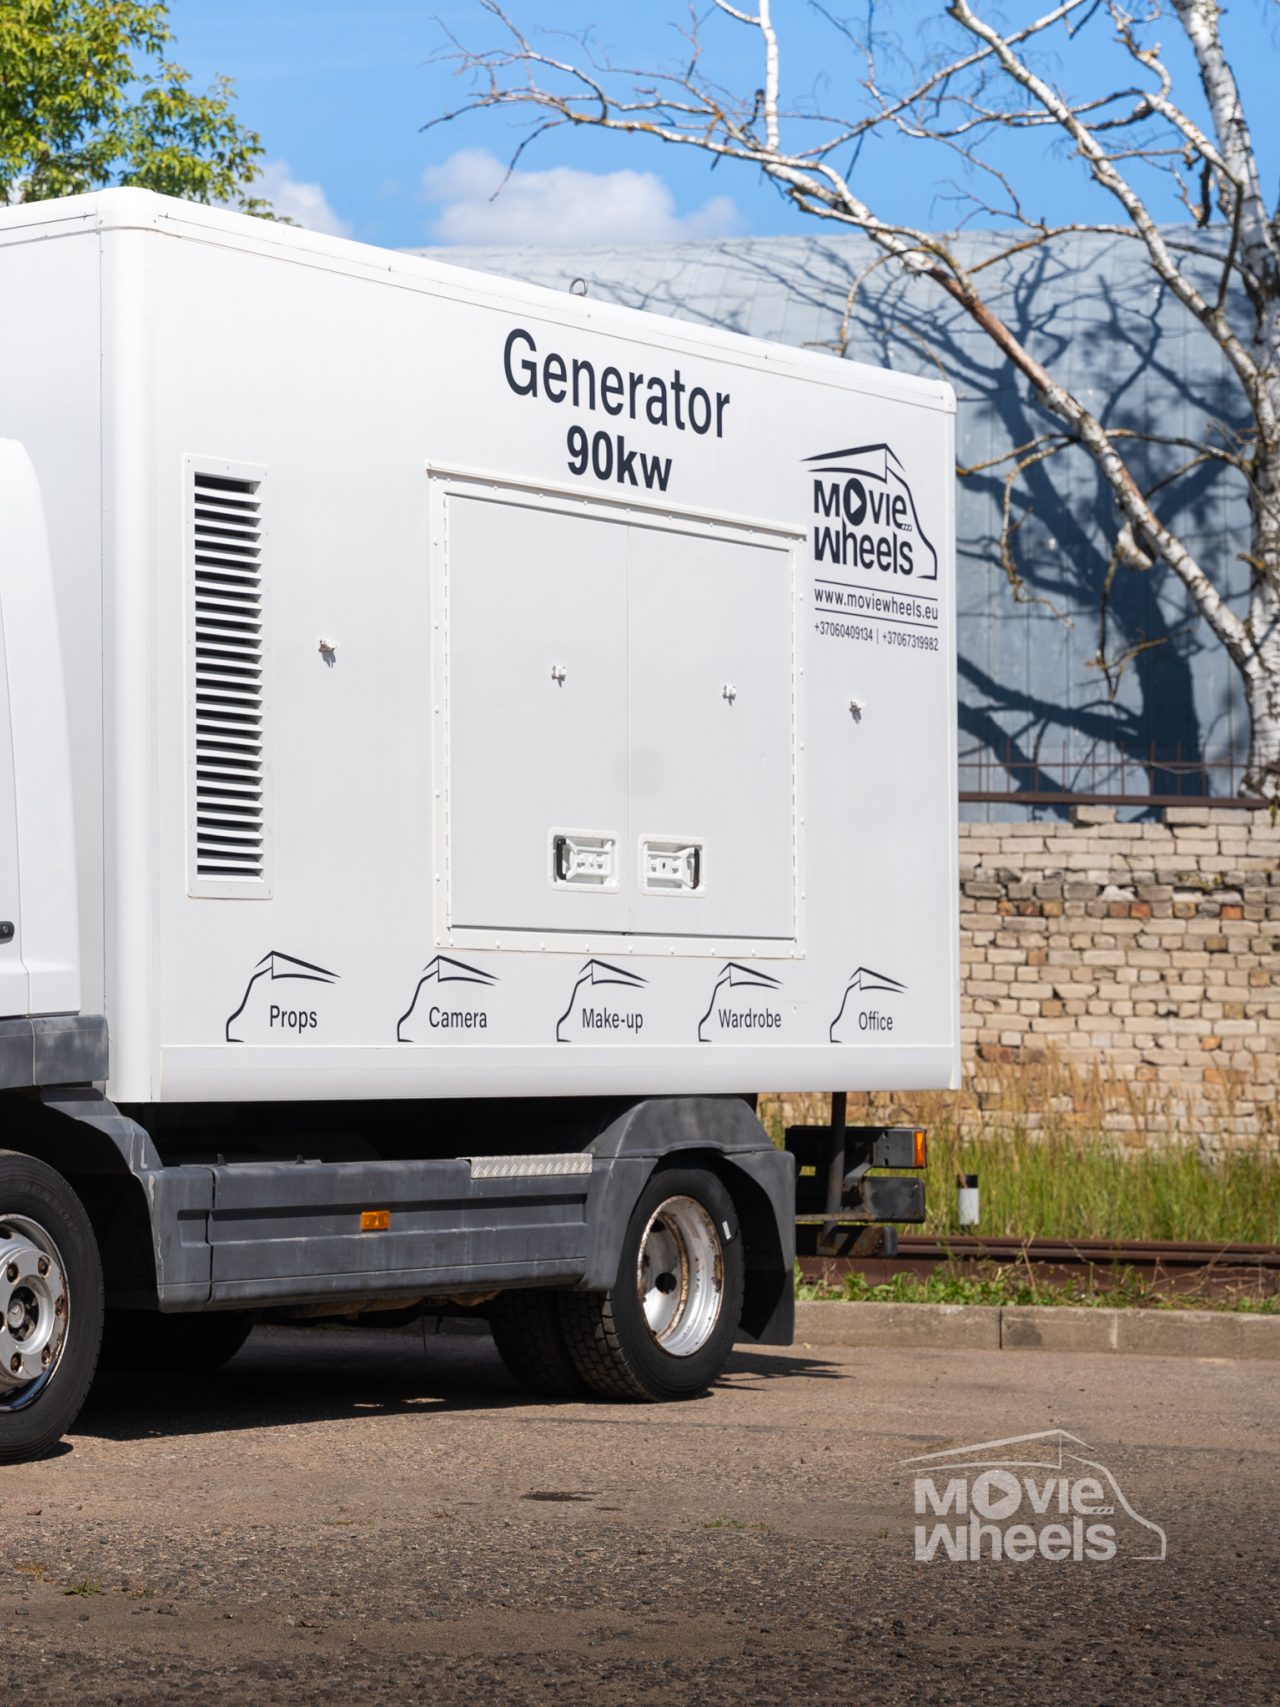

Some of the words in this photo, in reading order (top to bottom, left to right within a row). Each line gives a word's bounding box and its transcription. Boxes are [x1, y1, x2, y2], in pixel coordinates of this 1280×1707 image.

[503, 328, 731, 438] Generator
[566, 425, 673, 492] 90kw
[814, 588, 938, 620] www.moviewheels.eu
[814, 620, 873, 642] +37060409134
[882, 630, 938, 651] +37067319982
[269, 1005, 318, 1034] Props
[428, 1006, 488, 1029] Camera
[582, 1007, 644, 1034] Make-up
[718, 1008, 782, 1029] Wardrobe
[858, 1011, 894, 1031] Office
